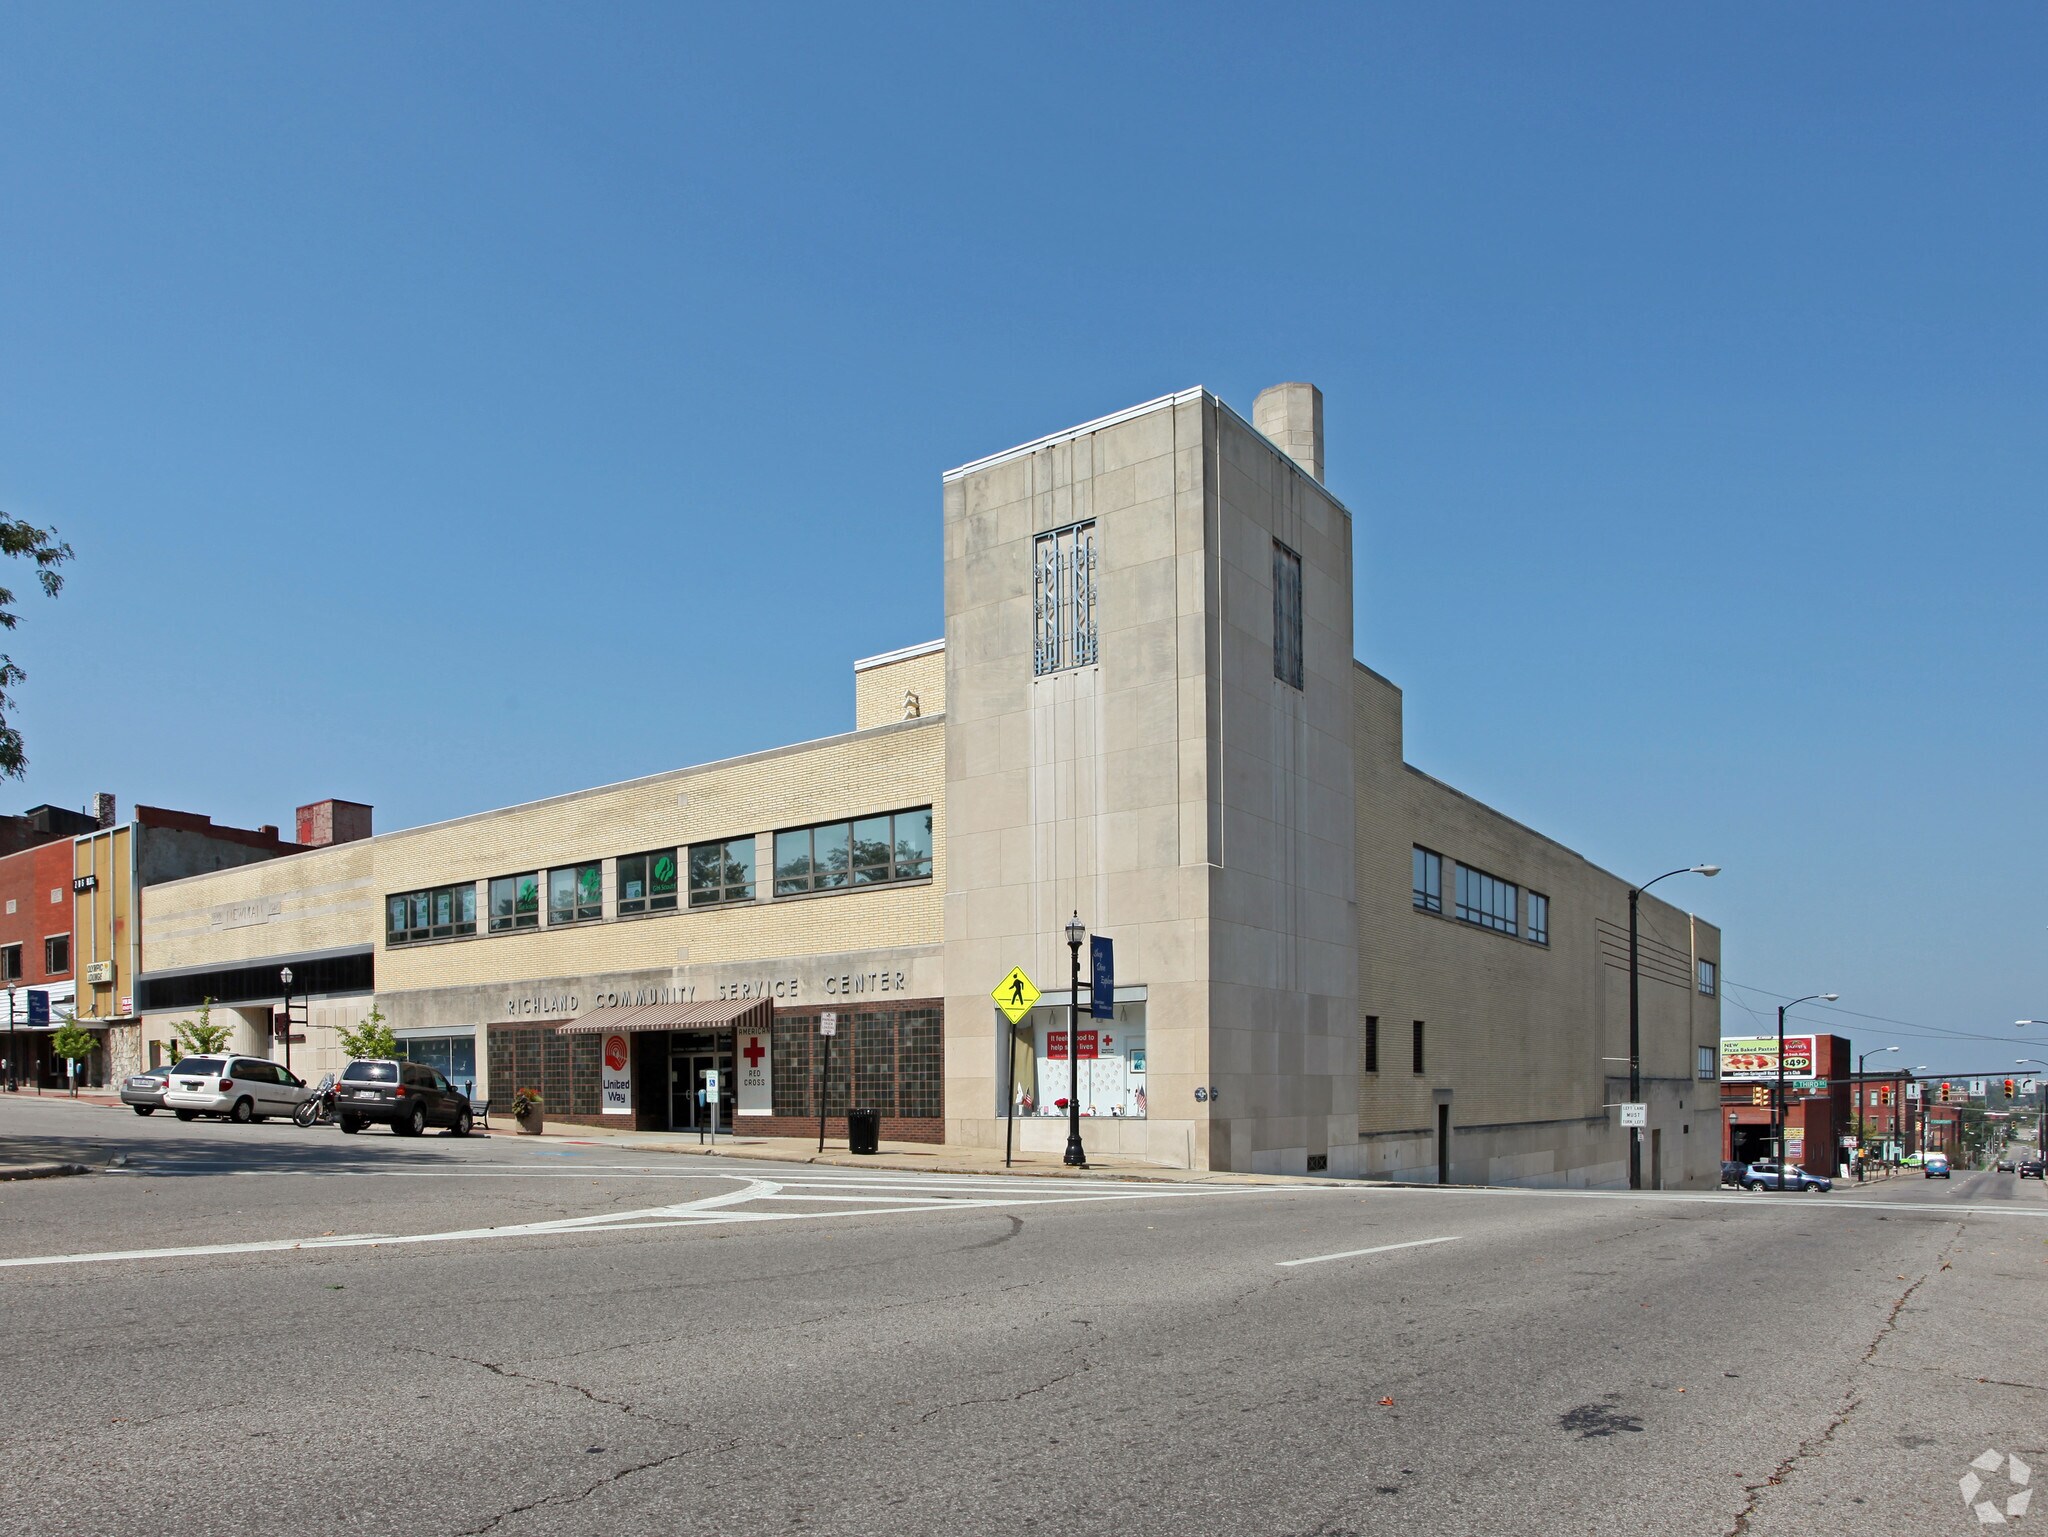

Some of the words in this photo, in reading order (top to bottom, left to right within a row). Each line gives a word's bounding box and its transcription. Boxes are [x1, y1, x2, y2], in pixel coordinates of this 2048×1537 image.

[507, 996, 579, 1016] RICHLAND
[595, 986, 697, 1009] COMMUNITY
[719, 977, 798, 1001] SERVICE
[824, 970, 905, 995] CENTER
[738, 1026, 771, 1036] AMERICAN
[748, 1069, 761, 1077] RED
[603, 1079, 630, 1090] United
[743, 1078, 766, 1087] CROSS
[1799, 1080, 1819, 1088] THIRD
[608, 1091, 626, 1103] Way
